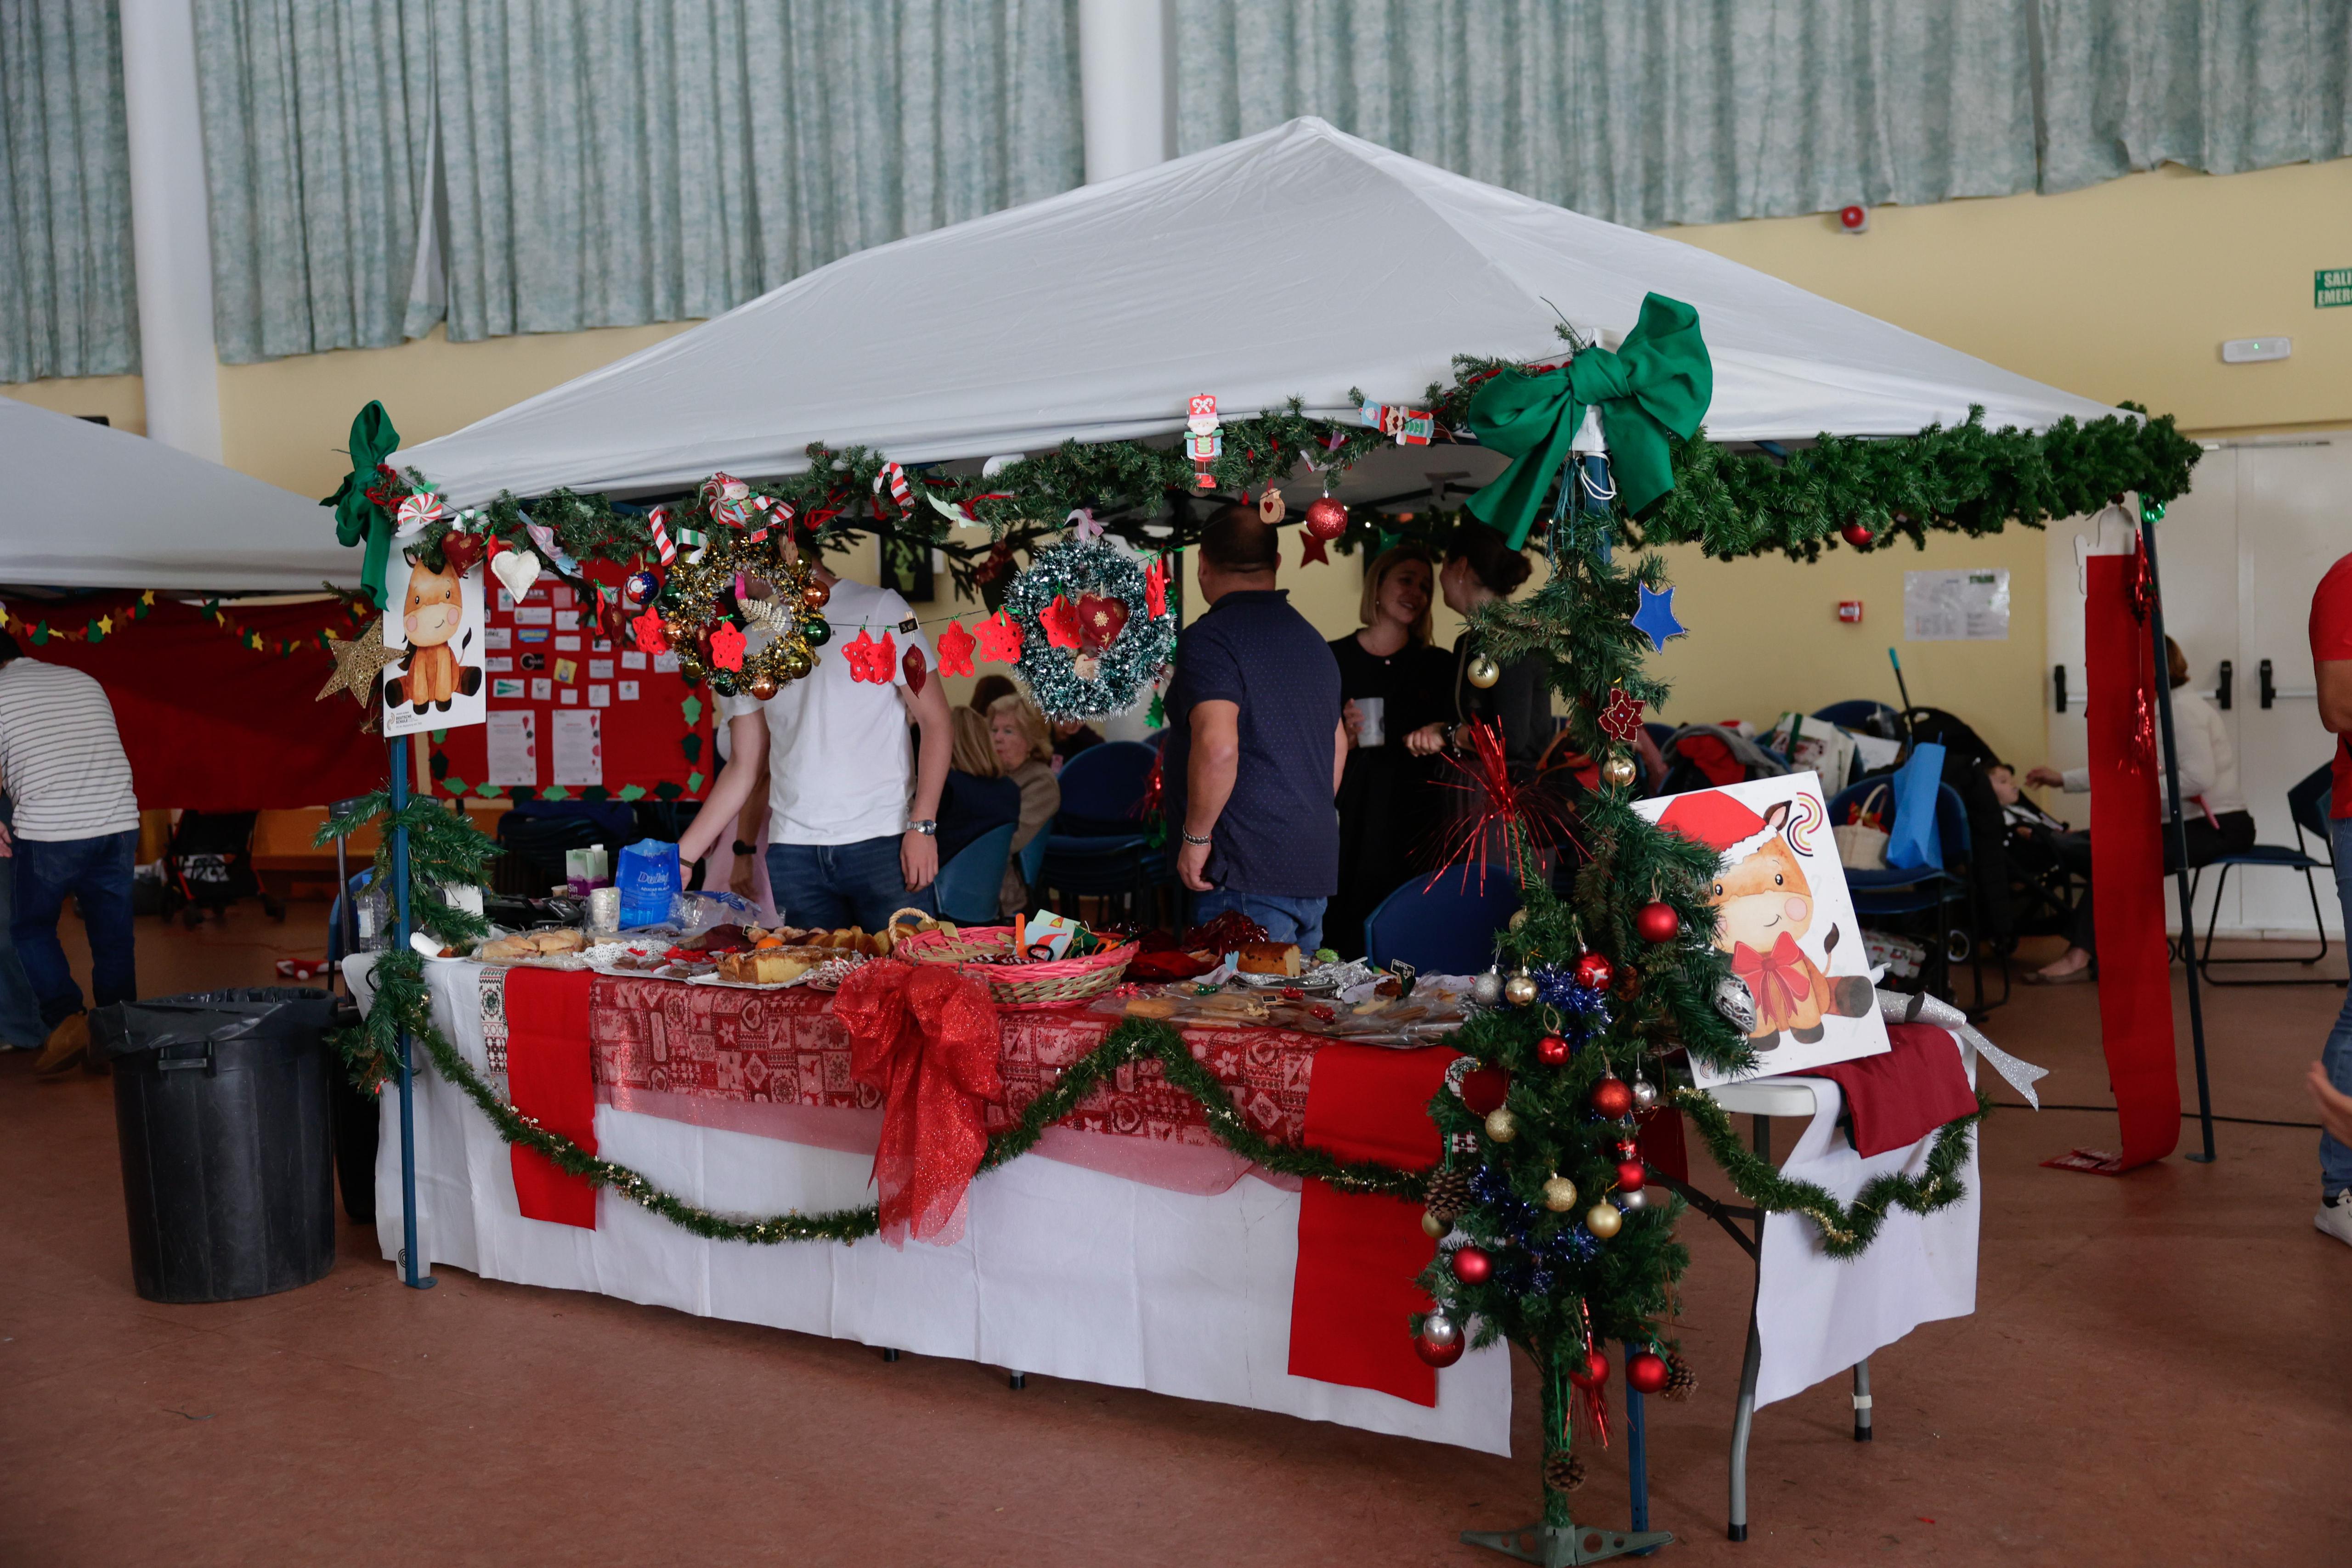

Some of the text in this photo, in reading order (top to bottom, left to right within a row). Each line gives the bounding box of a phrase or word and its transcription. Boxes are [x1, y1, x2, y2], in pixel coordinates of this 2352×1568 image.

[2324, 271, 2352, 288] SALI
[2318, 288, 2352, 305] EMER
[568, 883, 578, 893] Sin
